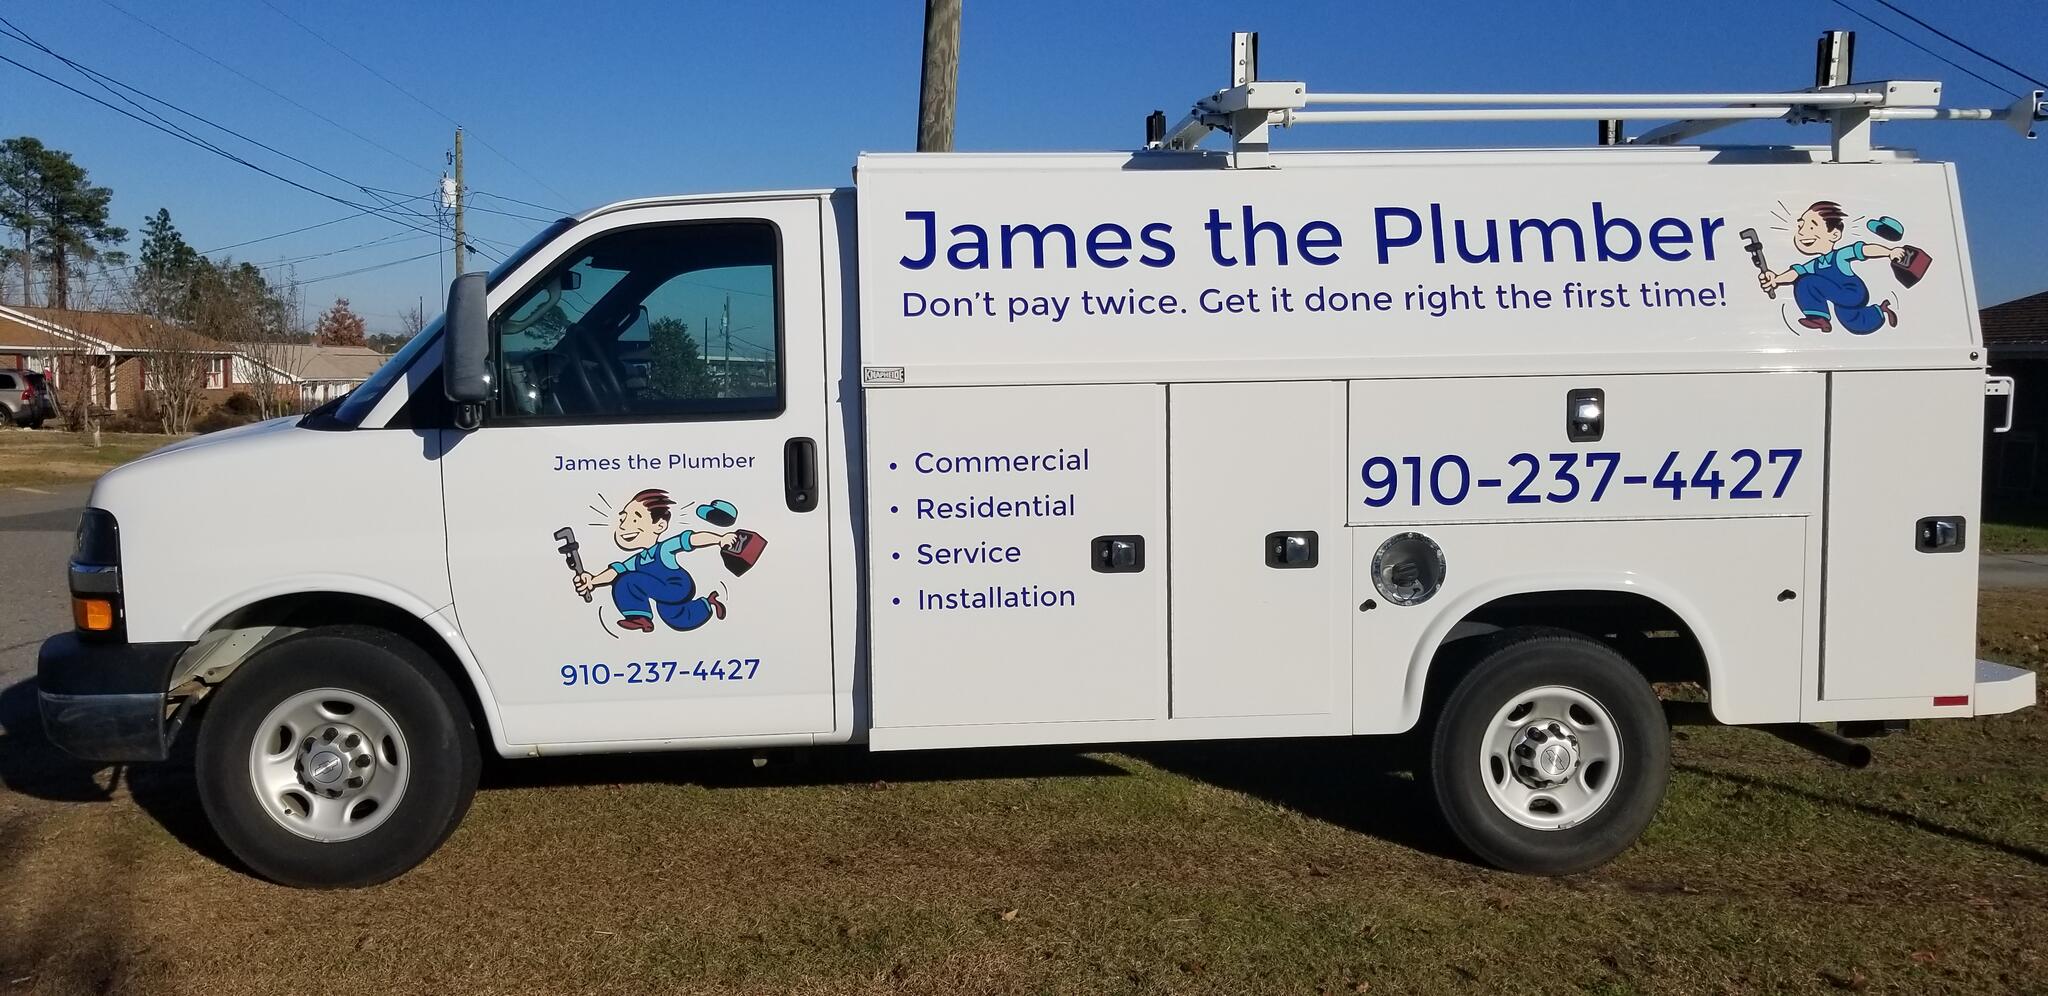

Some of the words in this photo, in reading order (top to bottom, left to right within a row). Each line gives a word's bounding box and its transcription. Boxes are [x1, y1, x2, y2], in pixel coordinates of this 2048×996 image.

[899, 210, 1176, 271] James
[1204, 204, 1343, 268] the
[1373, 201, 1725, 265] Plumber
[903, 291, 997, 317] Don't
[1008, 296, 1071, 322] pay
[1081, 287, 1187, 315] twice.
[1199, 288, 1261, 314] Get
[1271, 286, 1295, 313] it
[1304, 285, 1393, 313] done
[1404, 284, 1486, 318] right
[1495, 283, 1552, 309] the
[1562, 281, 1631, 308] first
[1639, 281, 1727, 308] time!
[865, 368, 904, 382] KNAPHEIDE
[553, 455, 621, 471] James
[627, 453, 662, 470] the
[668, 452, 756, 470] Plumber
[915, 448, 1090, 474] Commercial
[1361, 448, 1803, 508] 910-237-4427
[917, 493, 1075, 520] Residential
[917, 540, 1021, 565] Service
[919, 584, 1076, 611] Installation
[560, 658, 760, 687] 910-237-4427
